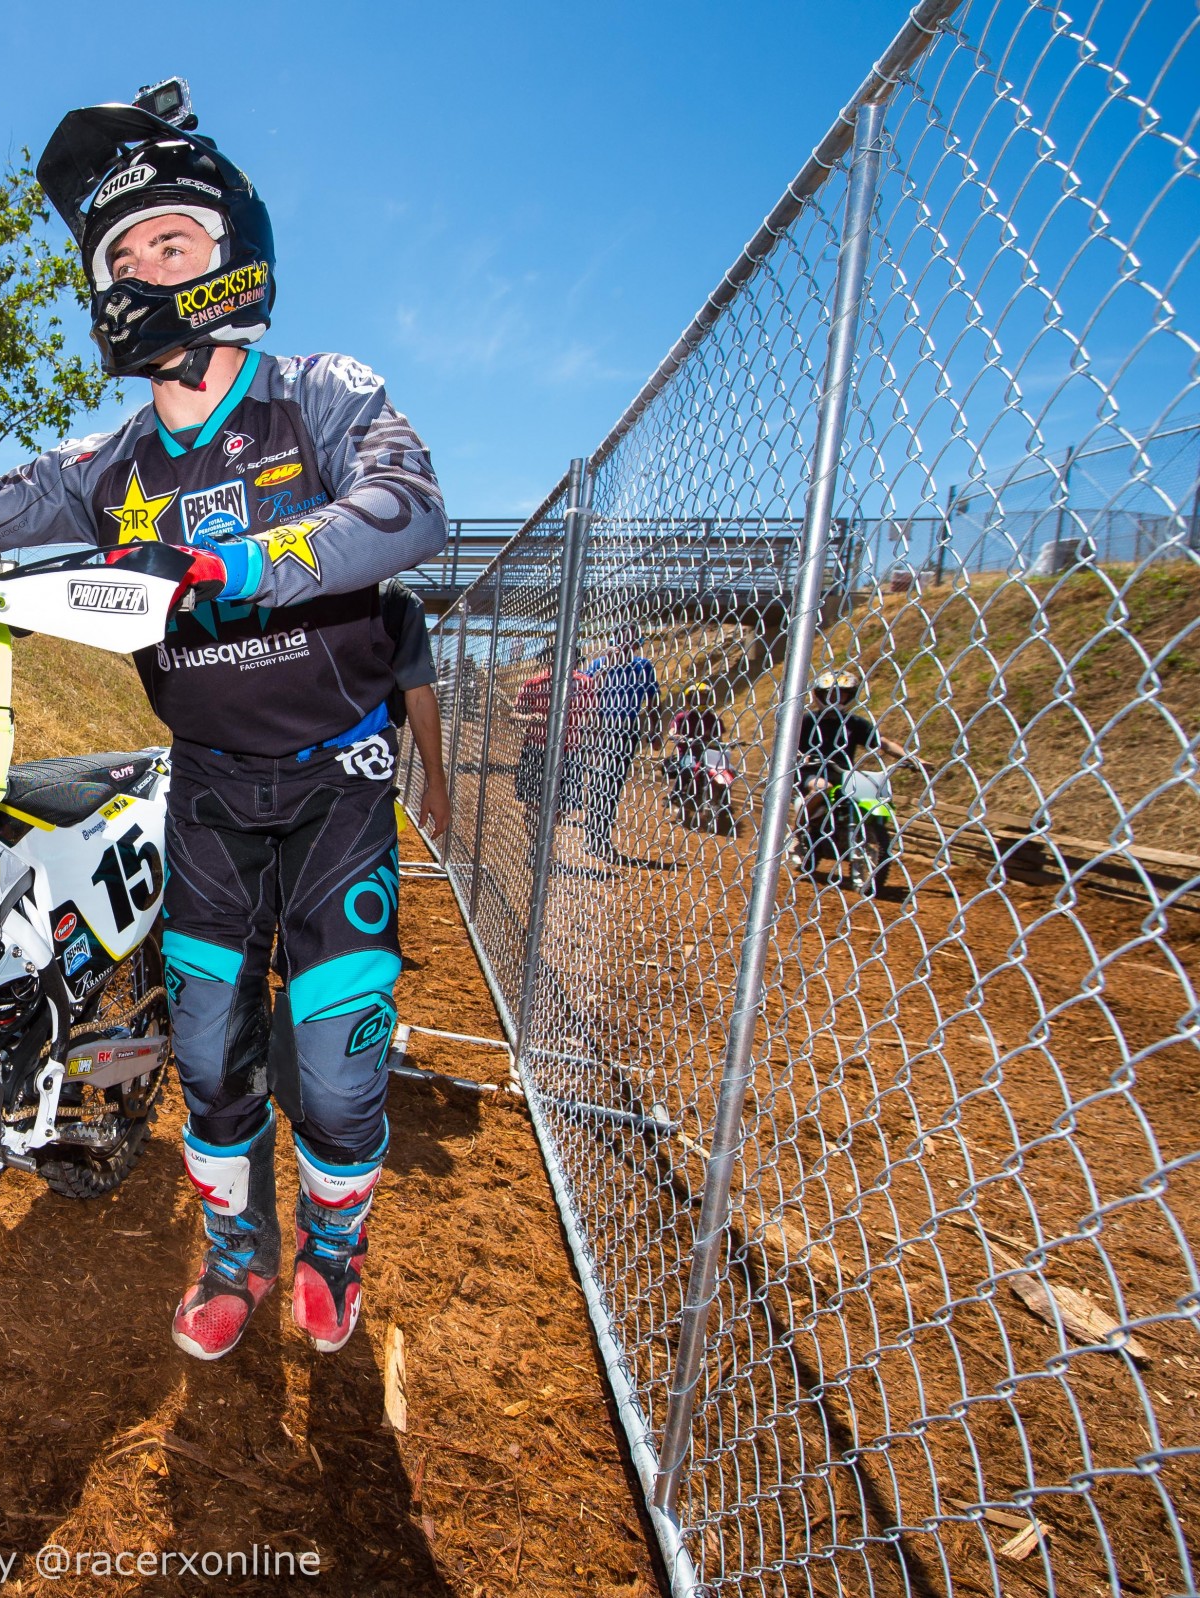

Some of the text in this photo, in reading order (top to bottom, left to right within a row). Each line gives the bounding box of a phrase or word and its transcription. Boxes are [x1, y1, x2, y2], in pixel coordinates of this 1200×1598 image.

[101, 167, 145, 199] SHOEI
[190, 287, 265, 326] ENERGY DRINK
[246, 446, 299, 470] SCOSCHE
[254, 463, 303, 487] FMF
[198, 519, 237, 535] PERFORMANCE
[208, 517, 224, 527] TOTAL
[72, 584, 145, 611] PROTAPER
[171, 626, 308, 669] Husqvarna
[239, 649, 310, 672] FACTORY RACING
[110, 764, 135, 780] GUTS
[91, 822, 164, 934] 15
[98, 1051, 112, 1062] RK
